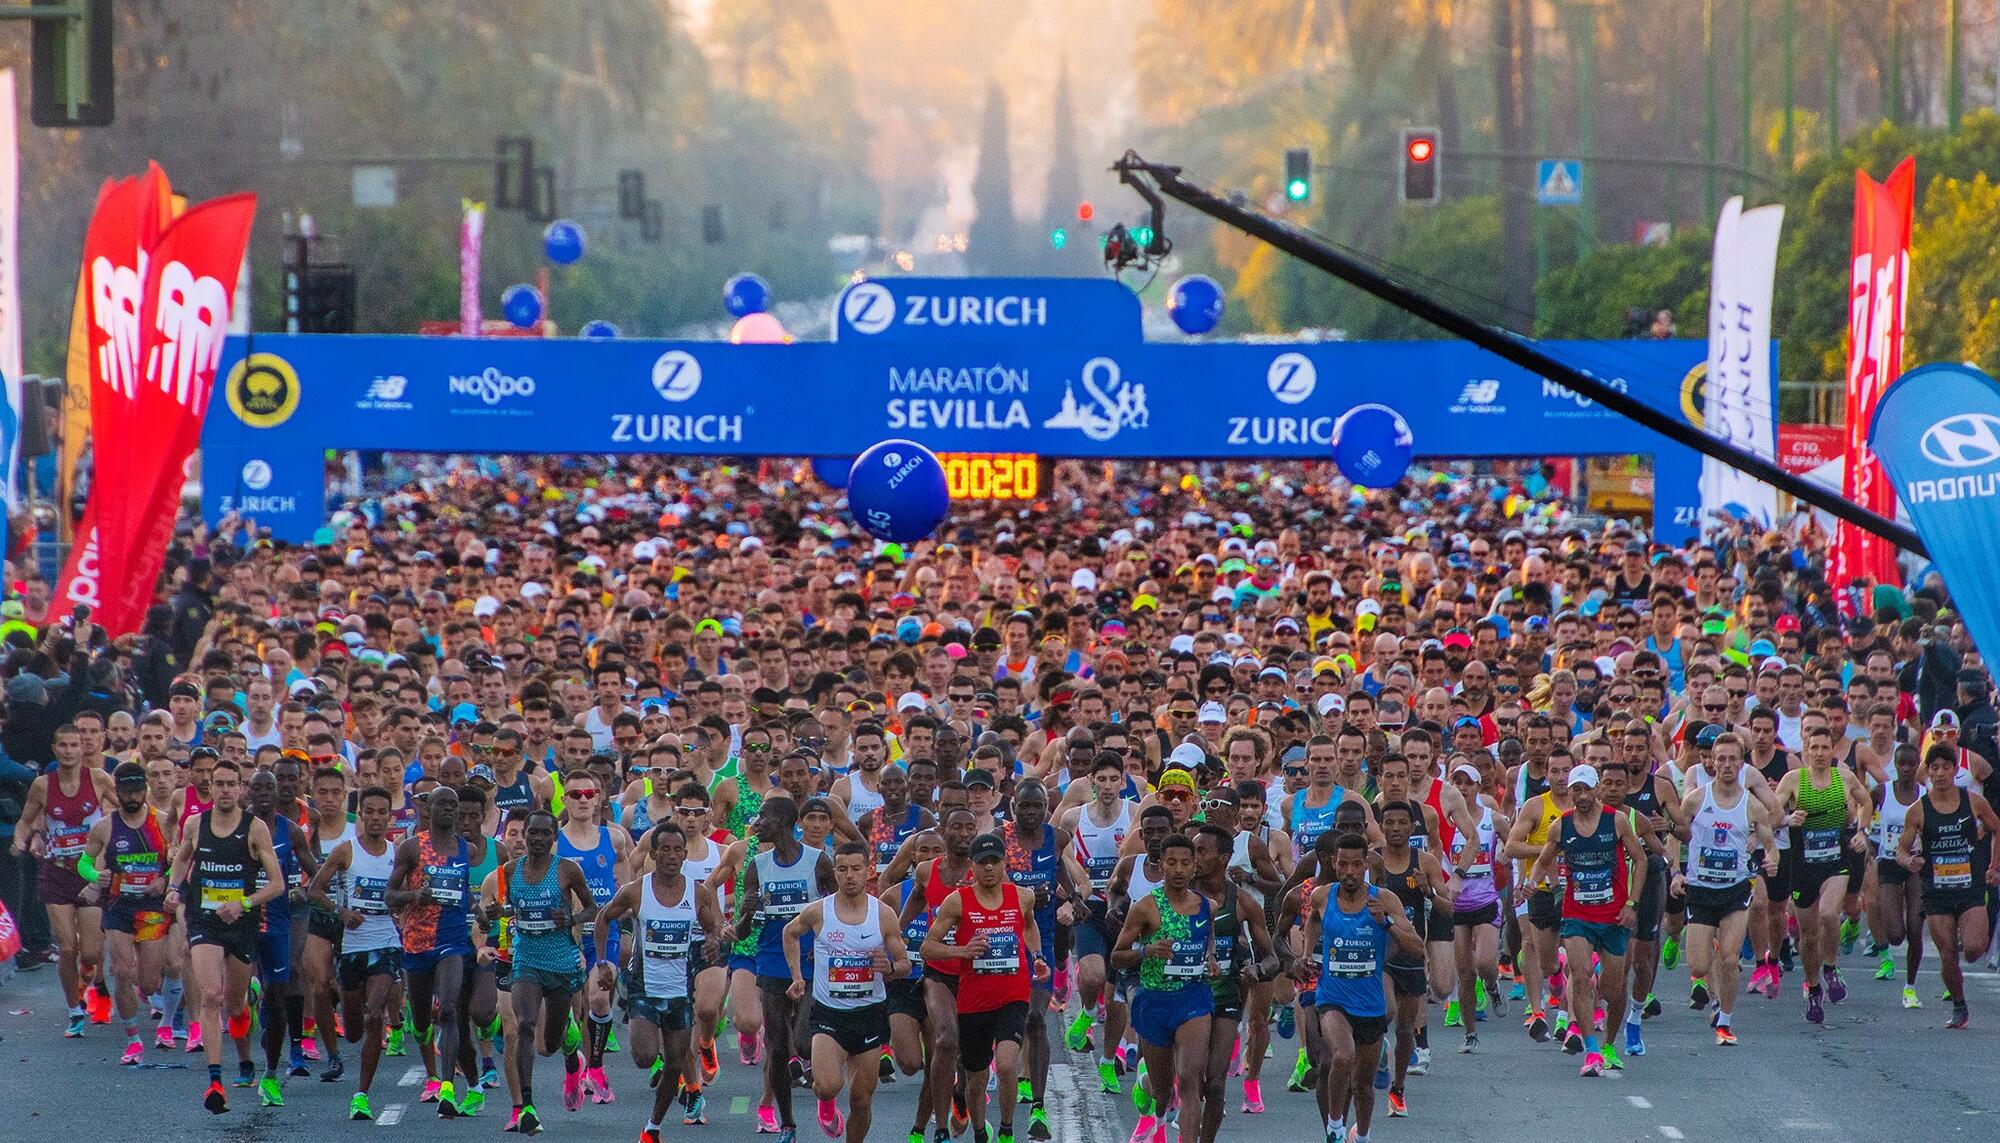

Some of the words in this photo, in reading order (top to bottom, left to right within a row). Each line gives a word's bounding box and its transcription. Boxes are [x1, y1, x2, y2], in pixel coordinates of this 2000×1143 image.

[904, 296, 1047, 327] ZURICH
[888, 362, 1029, 394] MARATÓN
[887, 398, 1031, 430] SEVILLA
[611, 414, 743, 443] ZURICH
[1227, 416, 1340, 445] ZURIC
[887, 455, 924, 489] ZURICH
[199, 860, 243, 873] Alimco
[437, 867, 462, 876] ZURICH
[776, 882, 802, 890] ZURICH
[528, 912, 543, 920] 362
[988, 935, 1014, 943] ZURICH
[991, 949, 1003, 957] 32
[1347, 952, 1359, 960] 85
[1184, 956, 1194, 964] 34
[845, 972, 860, 981] 201
